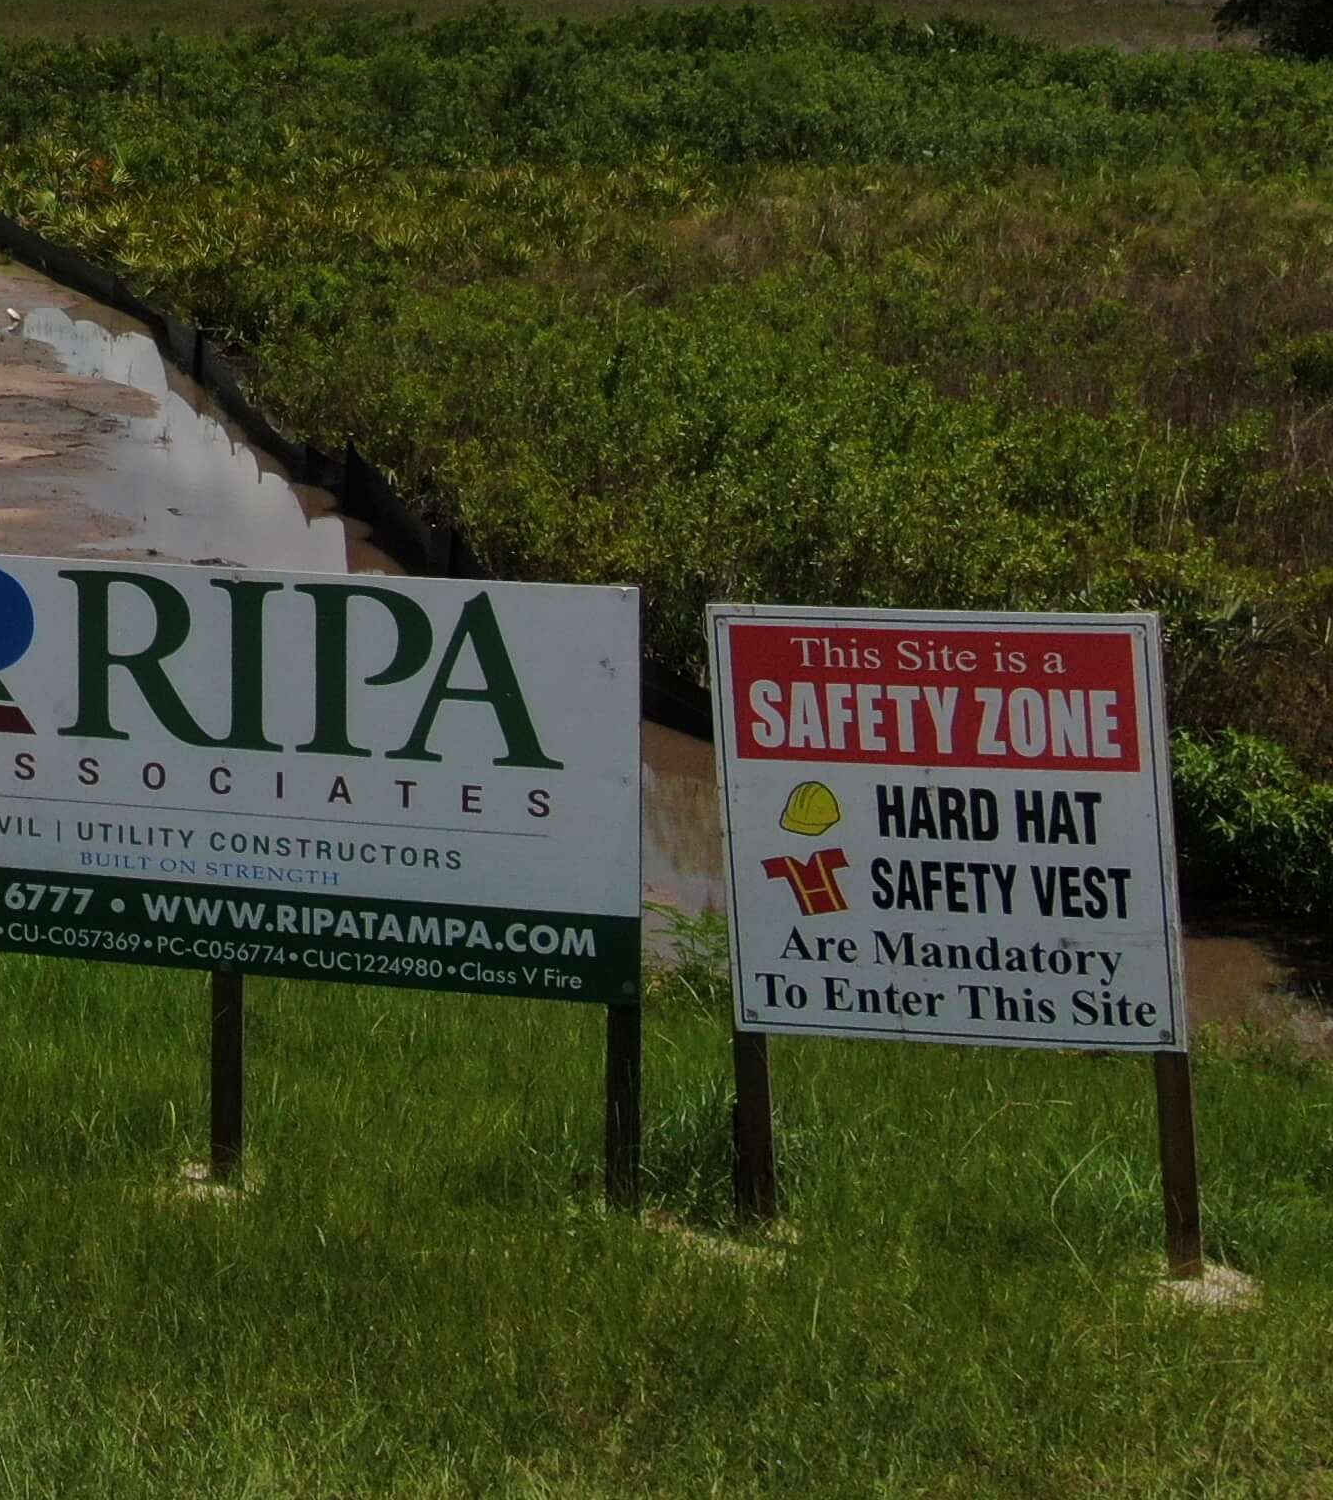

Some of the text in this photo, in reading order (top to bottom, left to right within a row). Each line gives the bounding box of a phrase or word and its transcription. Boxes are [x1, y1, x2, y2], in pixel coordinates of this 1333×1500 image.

[57, 569, 564, 770] RIPA
[790, 637, 1067, 674] This Site is a
[749, 679, 1122, 759] SAFETY ZONE
[876, 784, 1103, 846] HARD HAT
[77, 821, 194, 849] UTILITY
[209, 831, 462, 870] CONSTRUCTORS
[80, 851, 340, 886] BUILT ON STRENGTH
[870, 857, 1132, 920] SAFETY VEST
[143, 893, 596, 957] WWW.RIPATAMPA.COM
[460, 962, 517, 986] Class
[521, 967, 538, 986] V
[544, 968, 583, 990] Fire
[779, 926, 1123, 986] Are Mandatory
[755, 972, 1158, 1027] To Enter This Site
